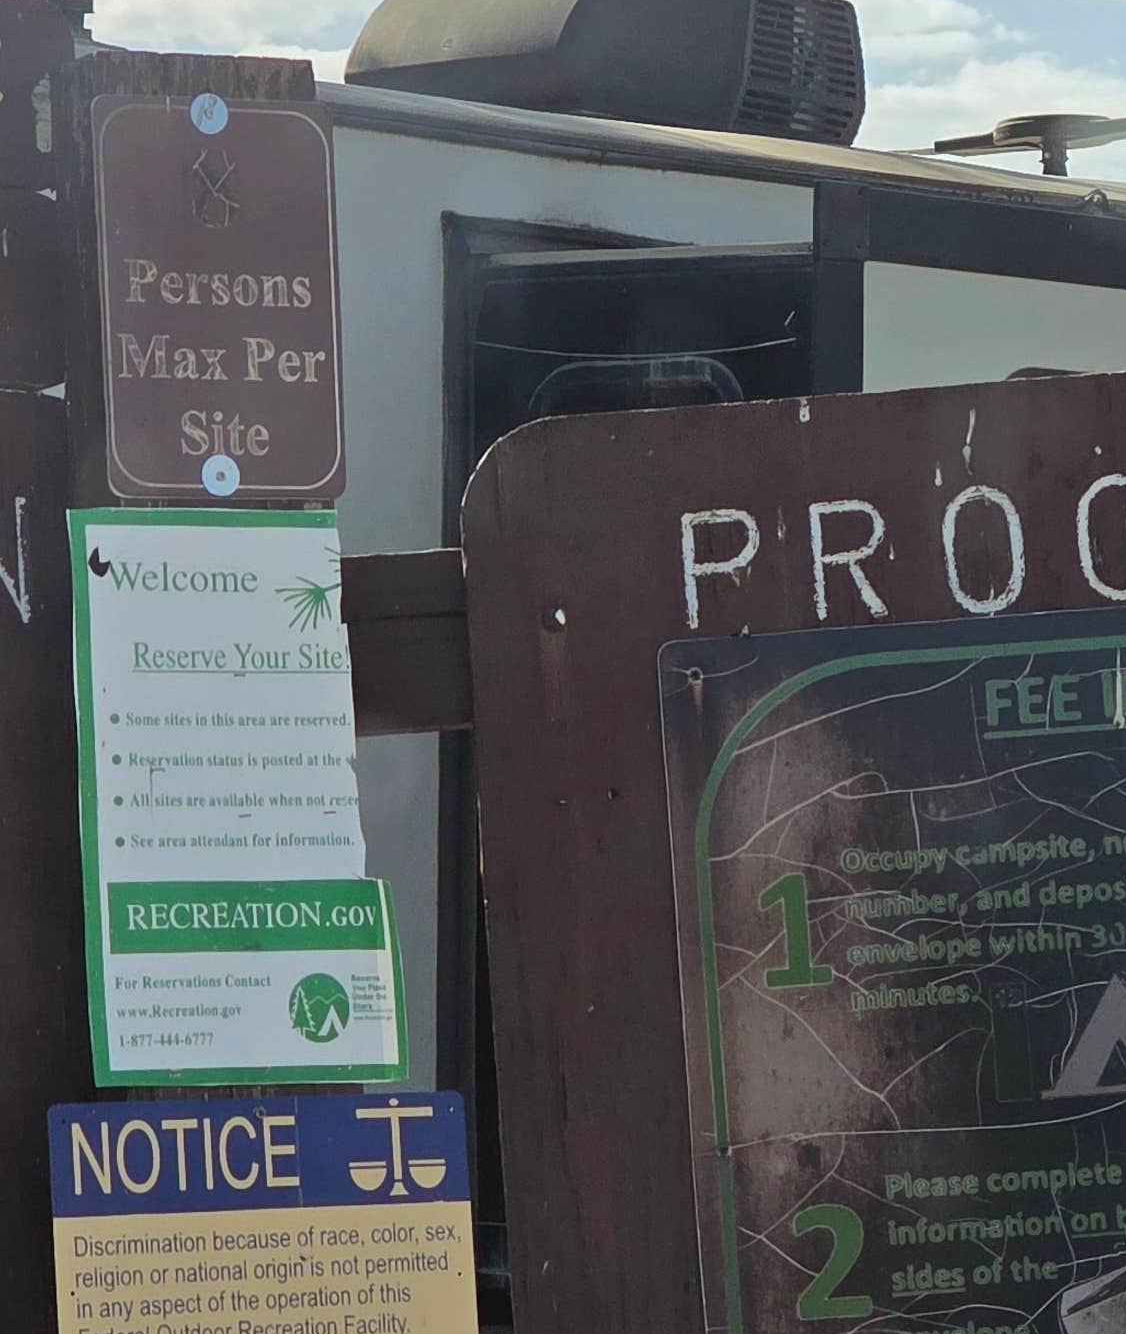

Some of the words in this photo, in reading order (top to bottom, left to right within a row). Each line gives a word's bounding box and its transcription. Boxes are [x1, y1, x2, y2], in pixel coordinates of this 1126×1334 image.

[123, 258, 312, 308] Persons
[118, 333, 229, 381] Max
[243, 336, 326, 384] Per
[181, 410, 271, 457] Site
[109, 560, 259, 593] Welcome
[132, 642, 226, 669] Reserve
[233, 643, 291, 669] Your
[985, 671, 1083, 727] FEE
[126, 713, 160, 726] Some
[164, 713, 192, 726] sites
[195, 713, 207, 726] in
[211, 713, 234, 726] this
[238, 715, 266, 726] area
[270, 715, 290, 726] are
[294, 712, 351, 726] reserved.
[128, 753, 204, 767] Reservation
[207, 753, 244, 766] status
[247, 752, 257, 766] is
[262, 752, 303, 769] posted
[307, 753, 319, 766] at
[322, 753, 341, 766] the
[130, 794, 149, 808] All
[154, 794, 182, 807] sites
[186, 796, 205, 807] are
[208, 793, 264, 807] available
[269, 793, 303, 806] when
[306, 794, 326, 806] not
[130, 835, 154, 848] See
[158, 836, 186, 848] area
[190, 833, 248, 848] attendant
[252, 833, 272, 847] for
[275, 832, 354, 847] information.
[839, 845, 947, 875] Occupy
[954, 833, 1097, 867] campsite,
[846, 888, 968, 920] number,
[976, 883, 1030, 911] and
[758, 873, 834, 989] 1
[847, 932, 981, 967] envelope
[990, 924, 1082, 956] within
[115, 976, 138, 990] For
[143, 975, 221, 990] Reservations
[224, 975, 271, 989] Contact
[851, 980, 980, 1012] minutes.
[117, 1004, 242, 1019] www.Recreation.gov
[70, 1115, 300, 1196] NOTICE
[884, 1171, 979, 1201] Please
[987, 1161, 1122, 1194] complete
[74, 1231, 206, 1257] Discrimination
[212, 1230, 291, 1252] because
[297, 1226, 315, 1247] of
[320, 1229, 365, 1247] race,
[371, 1222, 419, 1244] color,
[425, 1224, 461, 1243] sex,
[887, 1212, 1062, 1245] information
[1072, 1213, 1107, 1234] on
[75, 1266, 143, 1293] religion
[150, 1268, 168, 1285] or
[175, 1260, 247, 1283] national
[254, 1258, 304, 1284] origin
[310, 1256, 324, 1276] is
[331, 1255, 359, 1276] not
[366, 1251, 448, 1279] permitted
[792, 1204, 874, 1320] 2
[892, 1263, 966, 1292] sides
[973, 1261, 1004, 1285] of
[1012, 1257, 1059, 1282] the
[76, 1299, 92, 1319] in
[99, 1300, 133, 1322] any
[140, 1295, 202, 1320] aspect
[208, 1291, 226, 1312] of
[232, 1290, 259, 1311] the
[266, 1286, 351, 1315] operation
[357, 1284, 375, 1305] of
[380, 1283, 411, 1303] this
